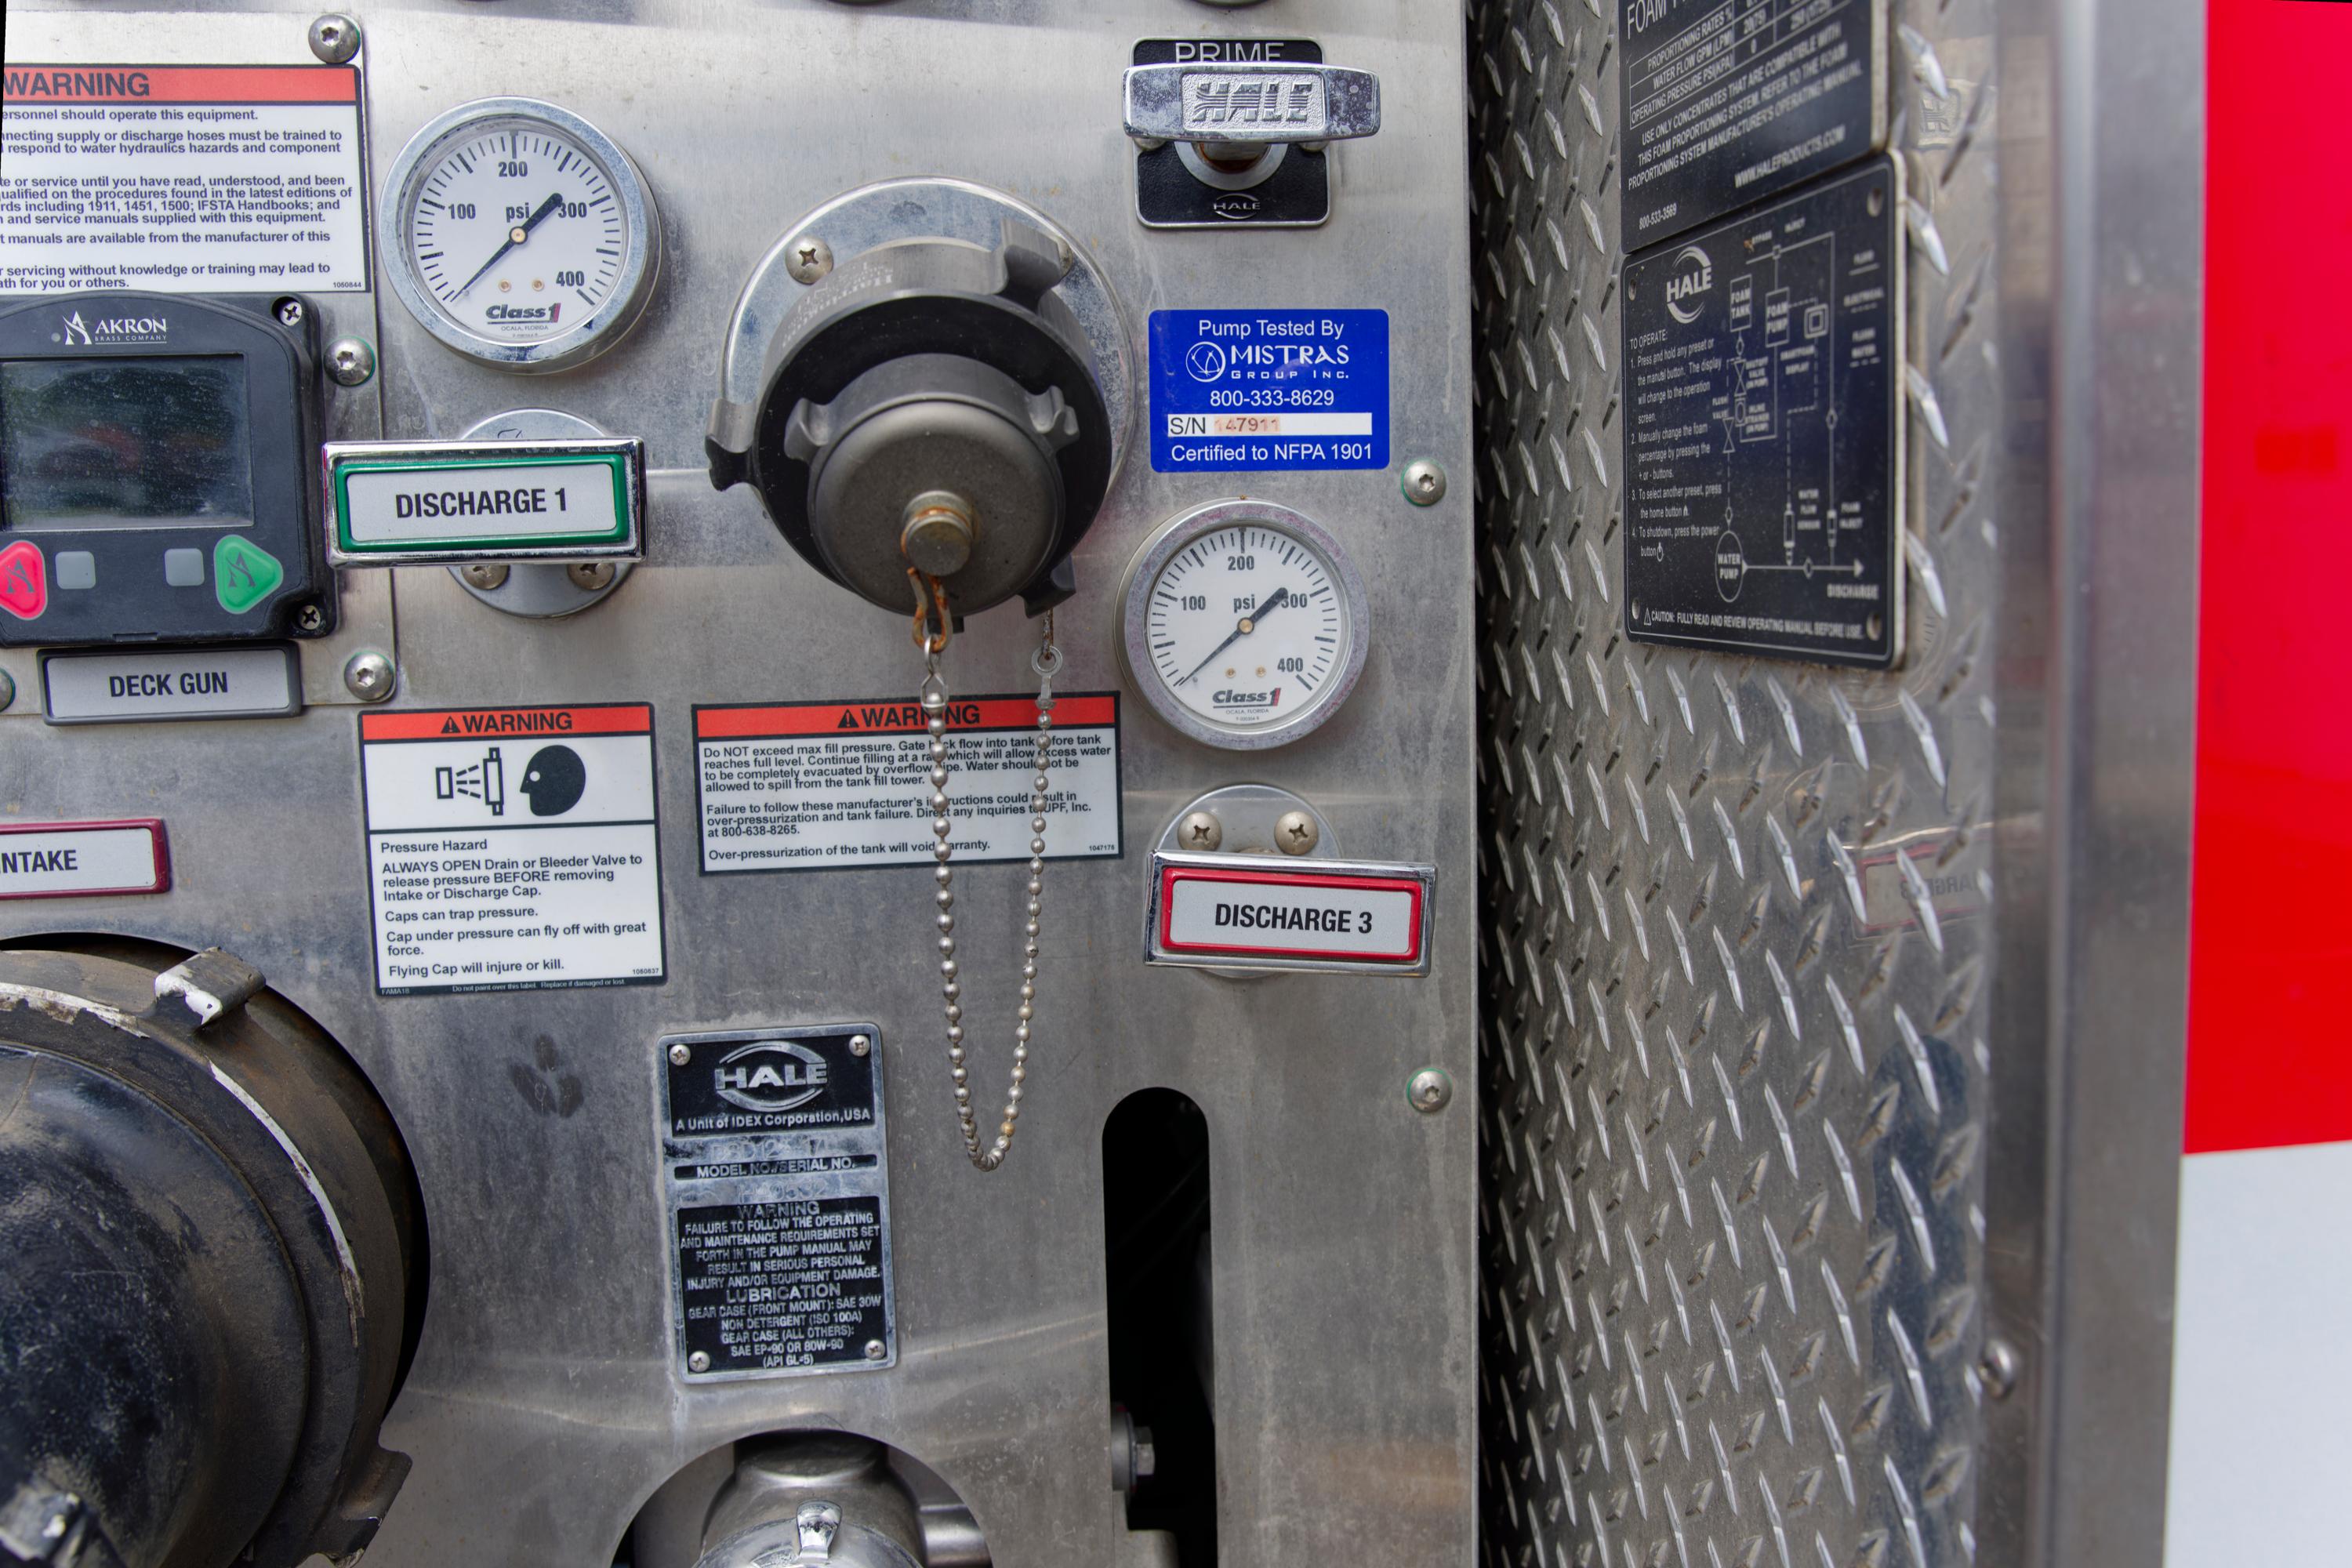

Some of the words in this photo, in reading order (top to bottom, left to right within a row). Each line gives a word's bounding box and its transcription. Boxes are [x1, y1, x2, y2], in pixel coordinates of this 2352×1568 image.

[1175, 42, 1283, 64] PRIME
[3, 72, 150, 96] WARNING
[60, 108, 105, 120] should
[108, 109, 157, 122] operate
[160, 108, 183, 120] this
[187, 109, 257, 122] equipment.
[1642, 130, 1655, 145] USE
[1656, 119, 1671, 139] ONLY
[1673, 92, 1727, 129] CONCENTRATES
[1729, 80, 1747, 96] THAT
[1748, 71, 1763, 87] ARE
[56, 130, 100, 143] supply
[103, 132, 118, 140] or
[121, 129, 183, 143] discharge
[187, 129, 225, 140] hoses
[228, 130, 261, 140] must
[264, 129, 279, 140] be
[282, 129, 326, 140] trained
[329, 130, 342, 140] to
[498, 161, 528, 177] 200
[448, 203, 476, 220] 100
[506, 202, 530, 223] psi
[558, 202, 587, 218] 300
[1639, 204, 1677, 230] 800-533-3569
[556, 270, 584, 286] 400
[1667, 267, 1712, 302] HALE
[1731, 289, 1751, 303] FOAM
[1731, 304, 1749, 318] TANK
[95, 318, 166, 334] AKRON
[1199, 319, 1250, 339] Pump
[1256, 319, 1314, 336] Tested
[1321, 319, 1344, 339] By
[1631, 338, 1638, 350] TO
[1639, 331, 1668, 347] OPERATE:
[1231, 344, 1348, 365] MISTRAS
[1637, 355, 1652, 367] Press
[1653, 350, 1663, 365] and
[1664, 346, 1675, 359] hold
[1676, 346, 1687, 358] any
[1688, 339, 1707, 357] preset
[1708, 339, 1715, 349] or
[1210, 389, 1334, 406] 800-333-8629
[1170, 416, 1207, 435] S/N
[1171, 444, 1245, 461] Certified
[1251, 445, 1268, 460] to
[1274, 443, 1326, 459] NFPA
[1330, 443, 1370, 459] 1901
[395, 488, 546, 518] DISCHARGE
[554, 487, 566, 511] 1
[1227, 555, 1254, 571] 200
[1717, 554, 1740, 564] WATER
[1719, 568, 1738, 579] PUMP
[1181, 595, 1206, 611] 100
[1233, 593, 1255, 613] psi
[1651, 610, 1675, 623] CAUTION:
[1677, 612, 1694, 624] FULLY
[1694, 613, 1710, 626] READ
[1711, 615, 1722, 627] AND
[1277, 657, 1303, 673] 400
[108, 673, 173, 697] DECK
[180, 671, 227, 695] GUN
[462, 711, 572, 733] WARNING
[861, 705, 980, 728] WARNNG
[703, 747, 720, 758] Do
[723, 746, 749, 757] NOT
[752, 744, 793, 757] exceed
[797, 746, 821, 754] max
[824, 742, 838, 753] fill
[841, 743, 895, 756] pressure.
[898, 740, 925, 751] Gate
[707, 827, 719, 837] at
[721, 824, 800, 837] 800-638-8265.
[380, 842, 438, 853] Pressure
[442, 838, 487, 851] Hazard
[0, 849, 78, 873] NTAKE
[382, 861, 438, 873] ALWAYS
[442, 859, 481, 871] OPEN
[485, 858, 518, 869] Drain
[522, 859, 536, 869] or
[539, 855, 589, 868] Bleeder
[592, 855, 626, 866] Valve
[629, 854, 642, 865] to
[383, 876, 430, 887] release
[433, 875, 490, 887] pressure
[493, 870, 550, 883] BEFORE
[554, 869, 614, 881] removing
[383, 889, 423, 901] Intake
[426, 891, 440, 899] or
[444, 887, 509, 899] Discharge
[512, 885, 541, 898] Cap.
[385, 910, 418, 924] Caps
[422, 911, 445, 920] can
[448, 909, 474, 921] trap
[477, 907, 538, 920] pressure.
[1214, 903, 1352, 932] DISCHARGE
[1358, 911, 1372, 934] 3
[386, 931, 412, 944] Cap
[416, 929, 454, 941] under
[457, 928, 514, 942] pressure
[517, 927, 540, 937] can
[543, 924, 559, 938] fly
[562, 924, 580, 935] off
[583, 923, 609, 934] with
[613, 921, 646, 935] great
[387, 945, 424, 956] force.
[389, 964, 428, 978] Flying
[432, 964, 458, 976] Cap
[461, 962, 482, 973] will
[486, 961, 522, 975] injure
[525, 962, 539, 971] or
[543, 959, 564, 970] kill.
[714, 1063, 827, 1089] HALE
[676, 1119, 684, 1131] A
[688, 1116, 714, 1130] Unit
[716, 1115, 728, 1128] of
[731, 1114, 761, 1127] IDEX
[696, 1163, 746, 1179] MODEL
[738, 1201, 820, 1218] WARNING
[685, 1221, 728, 1234] FAILURE
[731, 1220, 743, 1232] TO
[747, 1218, 789, 1231] FOLLOW
[792, 1216, 812, 1228] THE
[815, 1212, 873, 1226] OPERATING
[687, 1277, 724, 1290] INJURY
[728, 1274, 768, 1287] AND/OR
[771, 1269, 829, 1284] EQUIPMENT
[833, 1267, 880, 1280] DAMAGE.
[727, 1283, 840, 1303] LUBRICATION
[763, 1356, 782, 1369] (API
[786, 1353, 815, 1368] GL-5)
